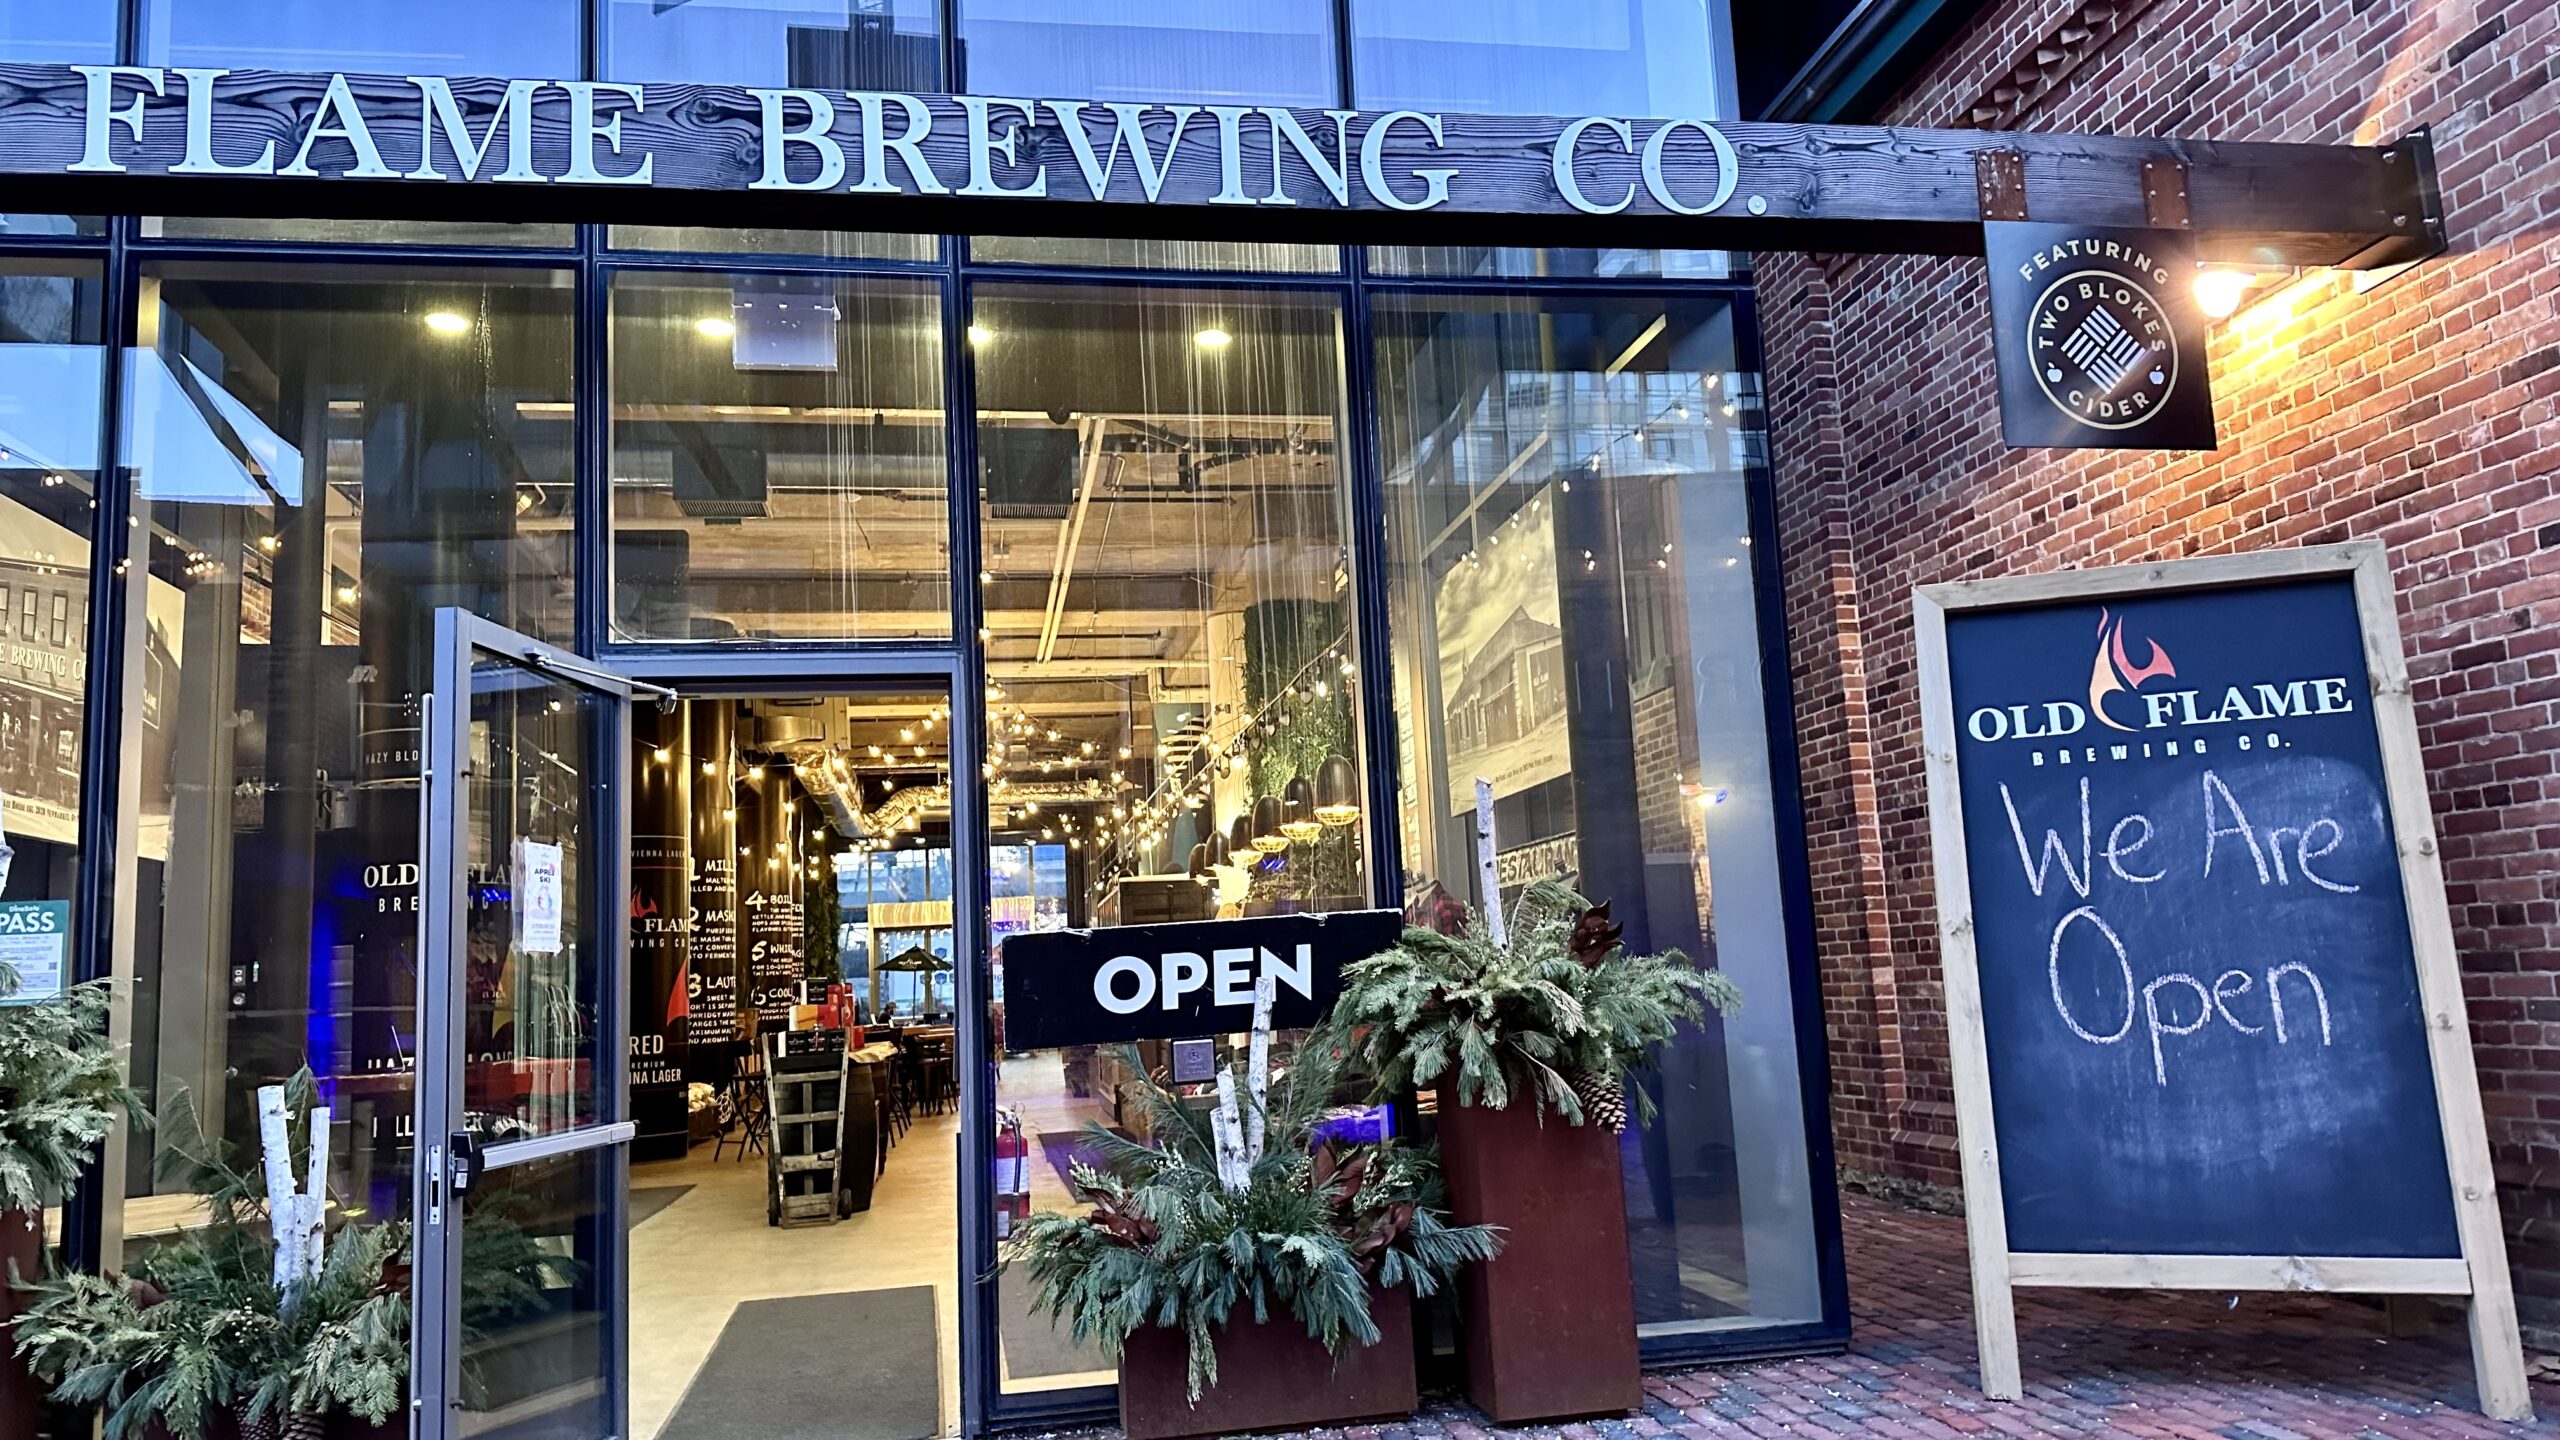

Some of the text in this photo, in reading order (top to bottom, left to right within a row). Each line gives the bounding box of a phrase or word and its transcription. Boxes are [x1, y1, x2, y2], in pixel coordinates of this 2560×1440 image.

[66, 65, 1768, 216] FLAME BREWING CO.
[2019, 239, 2169, 285] FEATURING
[2039, 282, 2167, 353] TWO BLOKES
[2068, 390, 2150, 418] CIDER
[10, 645, 66, 678] BREWING
[1968, 678, 2354, 743] OLD FLAME
[2032, 734, 2292, 767] BREWING CO.
[1999, 770, 2360, 899] We Are
[631, 849, 663, 858] VIENNA
[363, 863, 419, 889] OLD
[8, 905, 40, 913] DineSafe
[744, 890, 768, 912] 4
[751, 940, 768, 962] 5
[1093, 944, 1312, 1014] OPEN
[2048, 904, 2332, 1087] Open
[629, 1034, 664, 1056] RED
[631, 1060, 665, 1069] REMIUM
[652, 1068, 682, 1083] LAGER
